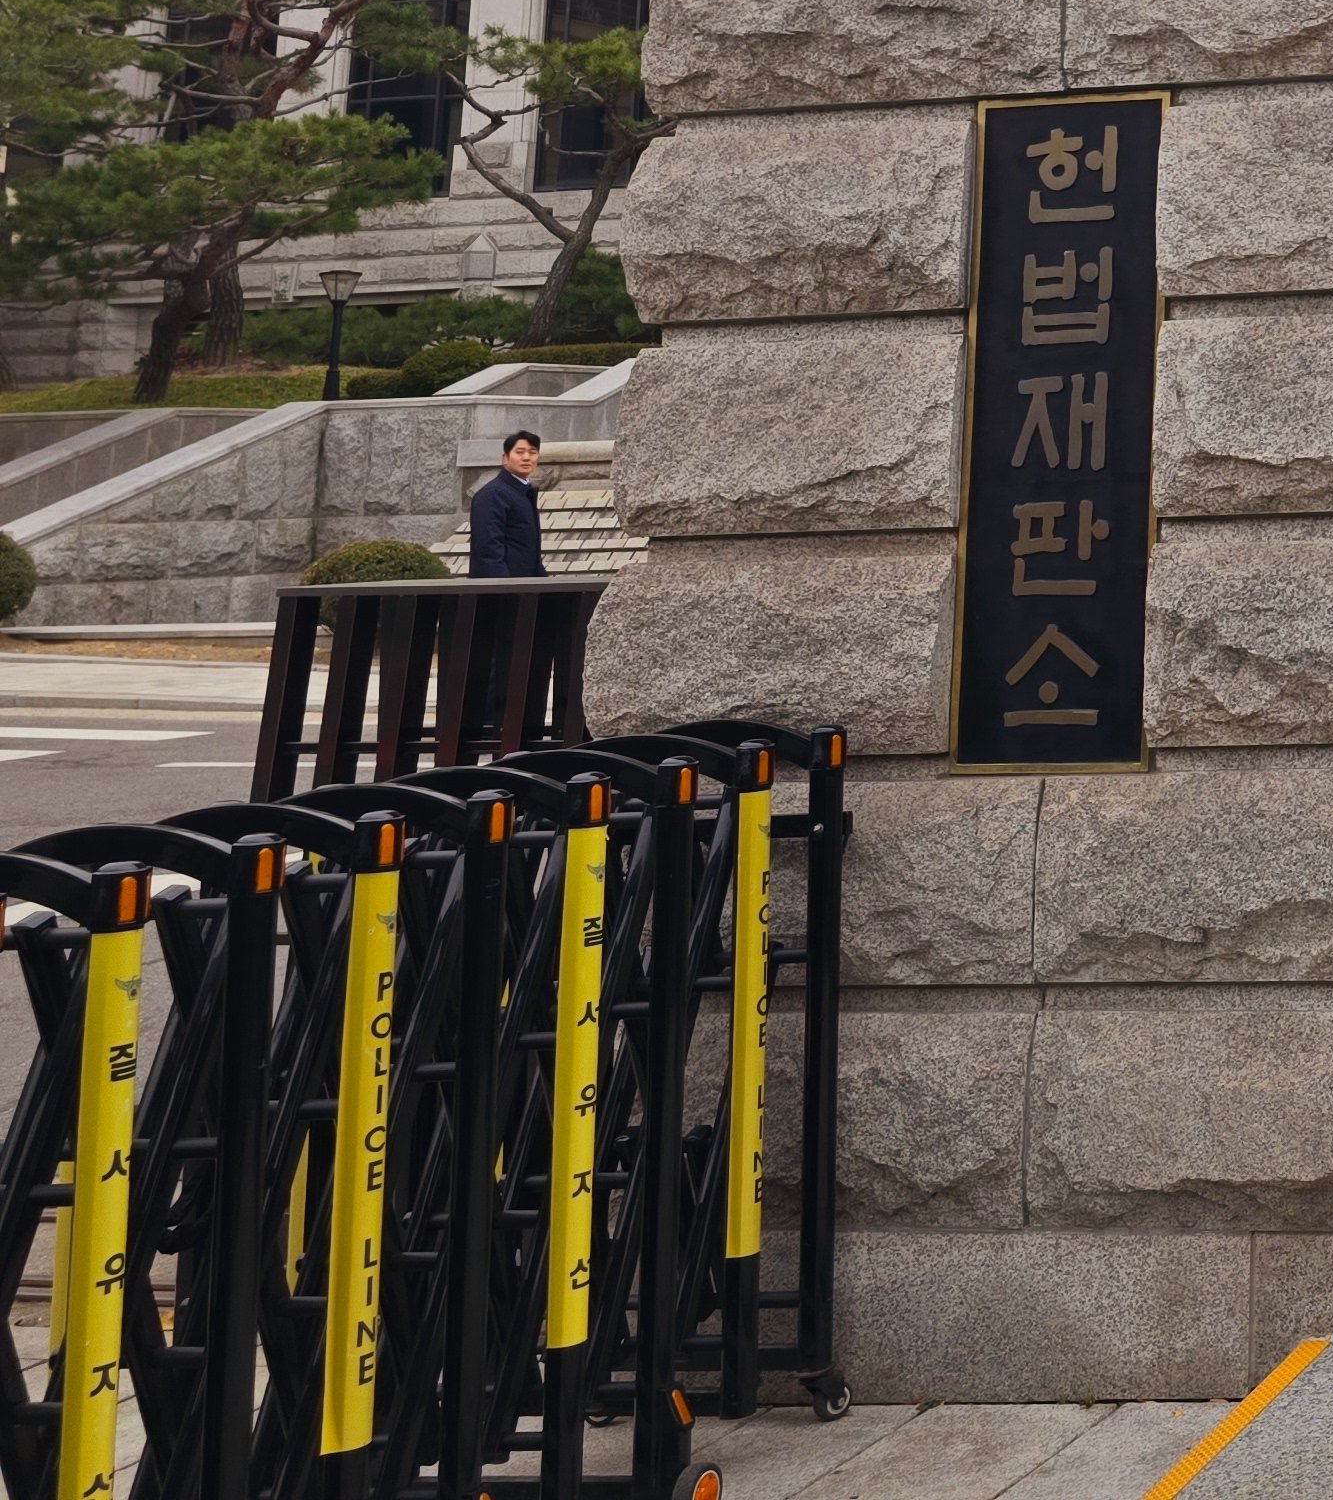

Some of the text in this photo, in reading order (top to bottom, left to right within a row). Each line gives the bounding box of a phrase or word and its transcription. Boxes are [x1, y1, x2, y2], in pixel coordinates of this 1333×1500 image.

[1003, 124, 1119, 728] 헌법재판소
[356, 971, 393, 1386] POLICE LINE
